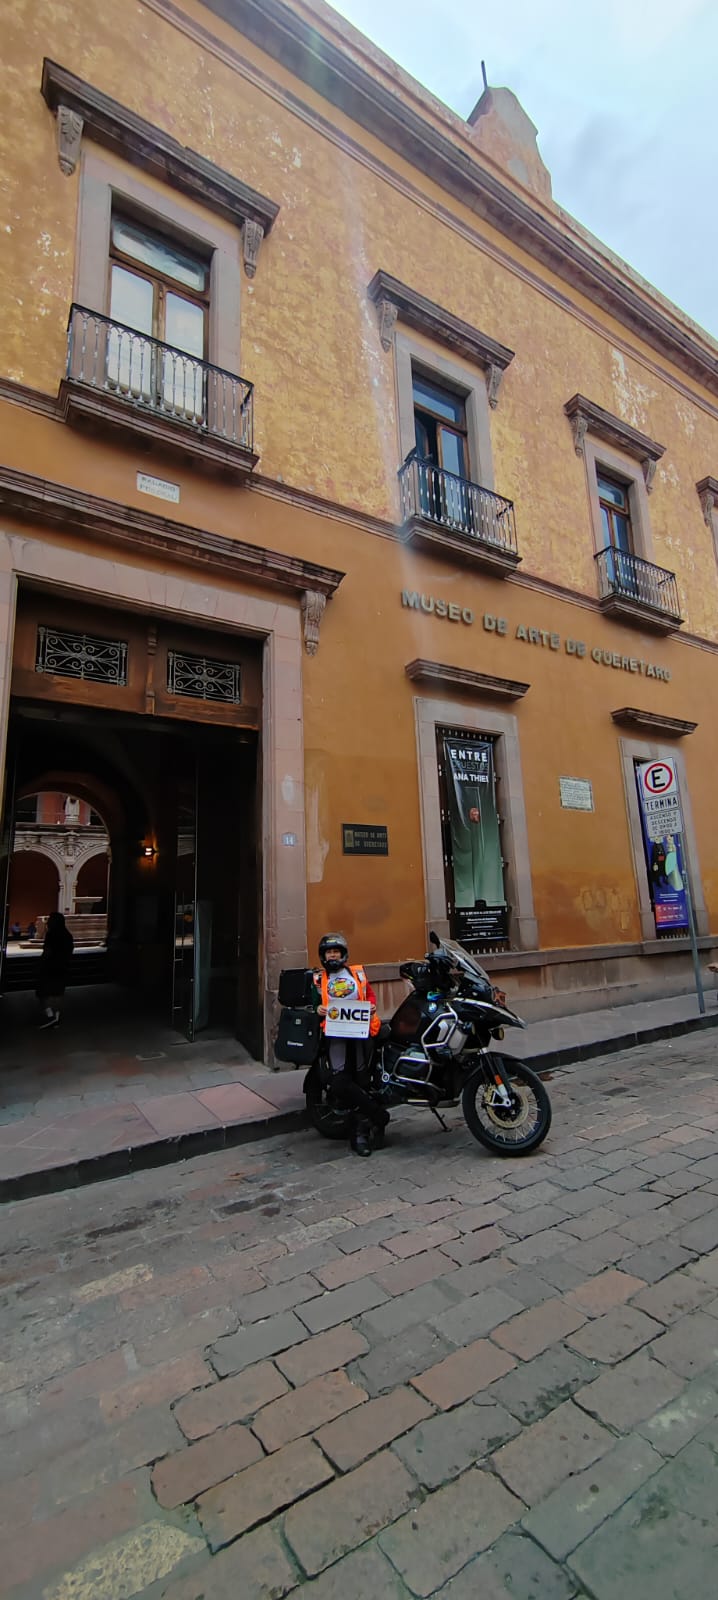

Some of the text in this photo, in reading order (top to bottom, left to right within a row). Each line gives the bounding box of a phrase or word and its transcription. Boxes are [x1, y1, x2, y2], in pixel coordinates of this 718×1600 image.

[401, 590, 673, 682] MUSEO DE ARTE DE QUERETARO
[450, 749, 488, 762] ENTRE
[651, 768, 666, 788] E
[646, 796, 678, 811] TERMINA
